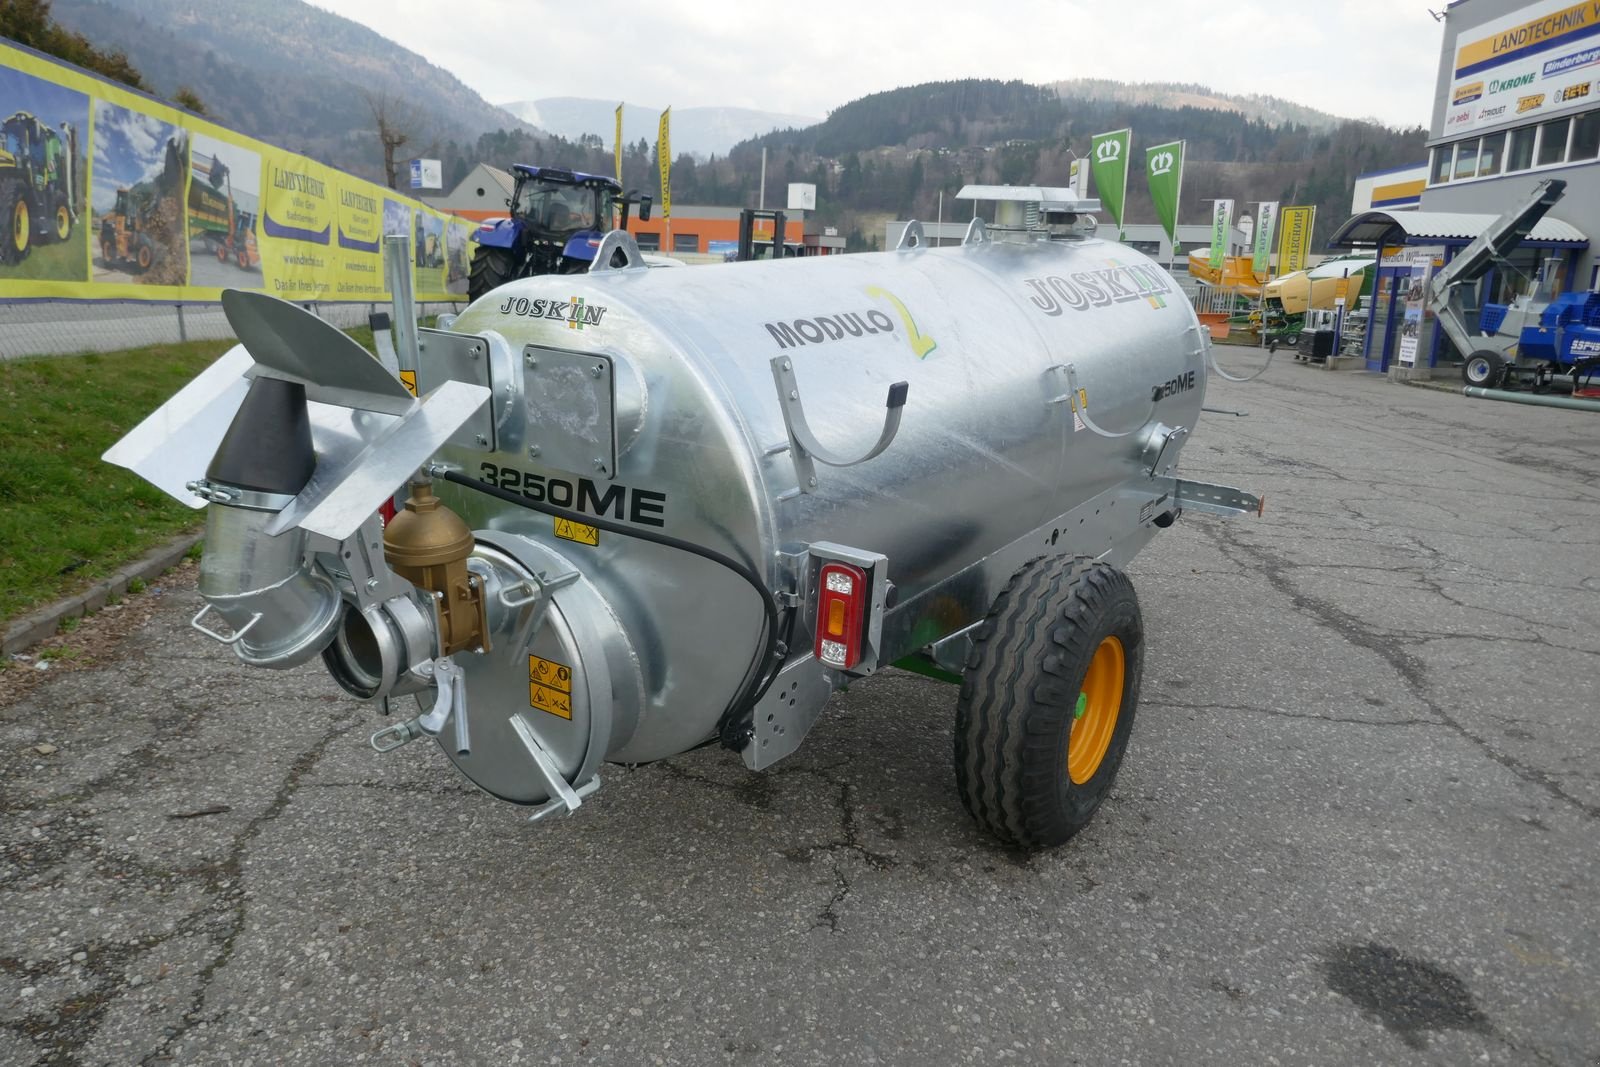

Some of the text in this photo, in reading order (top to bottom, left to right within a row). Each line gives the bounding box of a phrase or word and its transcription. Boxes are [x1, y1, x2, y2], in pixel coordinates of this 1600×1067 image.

[1492, 6, 1586, 53] LANDTECHNIK
[1499, 72, 1537, 92] KRONE
[500, 296, 607, 326] JOSKIN
[1024, 263, 1173, 317] JOSKIN
[764, 309, 894, 349] MODULO
[479, 461, 667, 528] 3250ME
